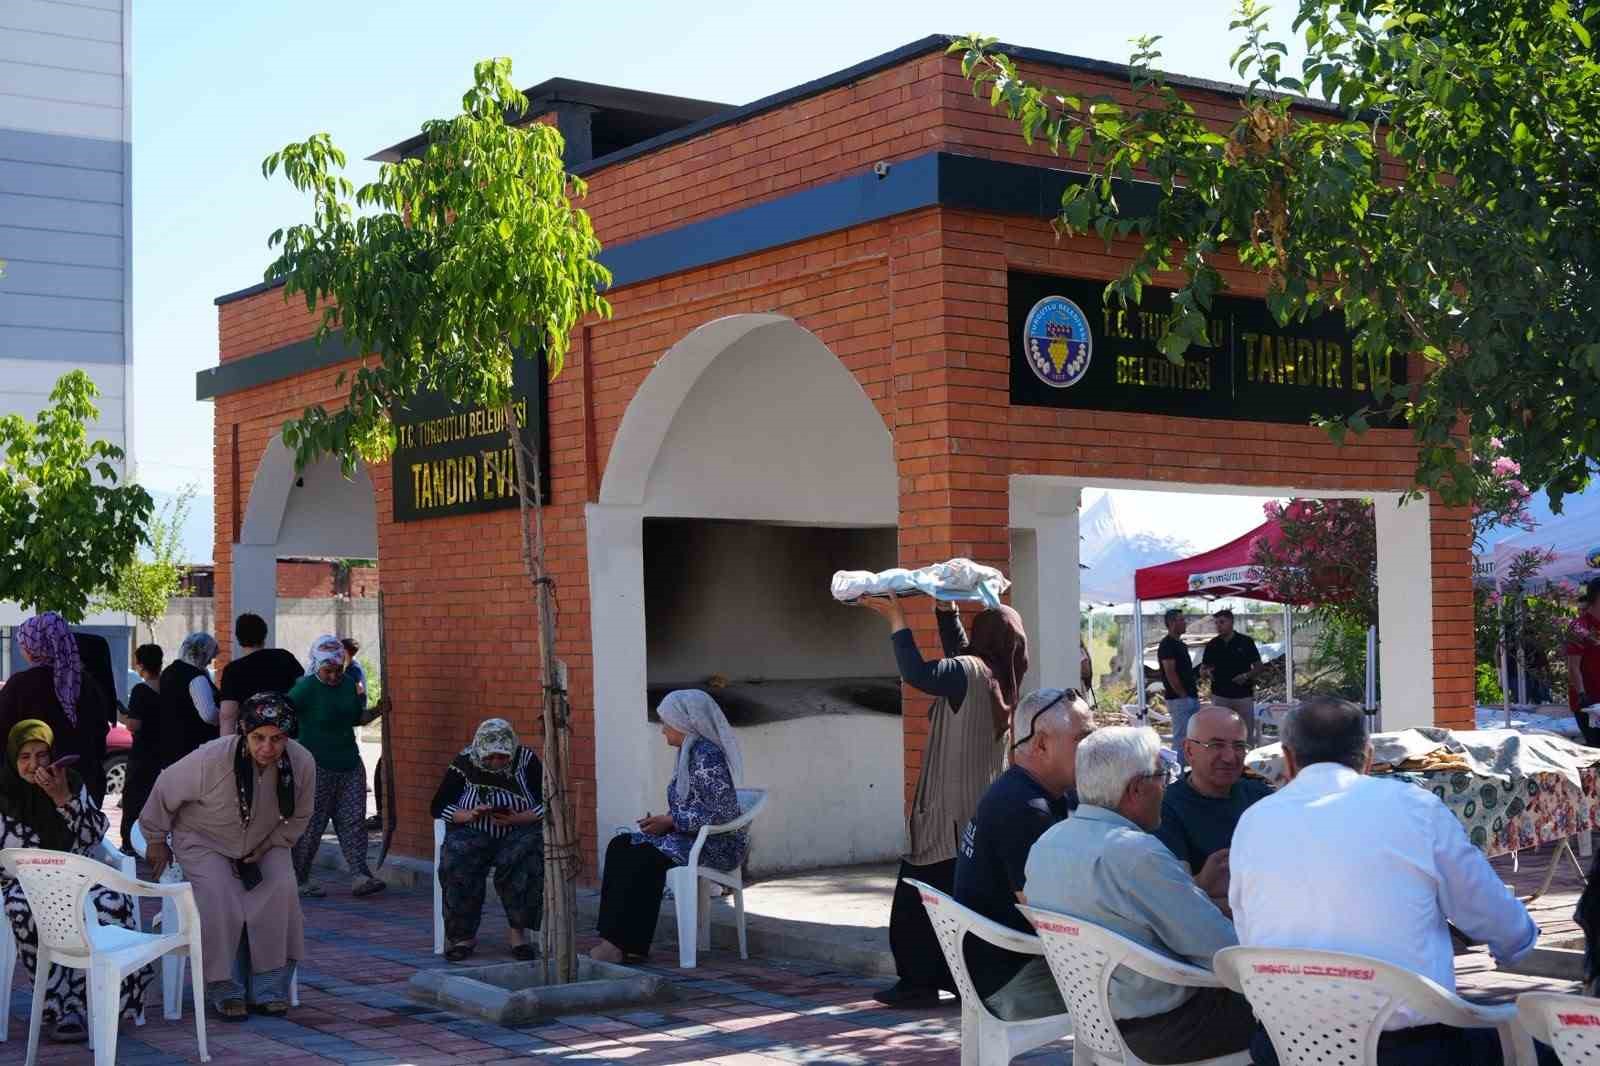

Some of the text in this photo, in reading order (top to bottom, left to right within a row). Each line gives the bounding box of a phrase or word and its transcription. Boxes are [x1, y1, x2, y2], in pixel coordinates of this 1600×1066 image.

[1242, 333, 1343, 389] TANDIR
[400, 425, 416, 449] T.C.
[419, 413, 467, 450] TURGUTLU
[411, 438, 514, 509] TANDIR EVİ
